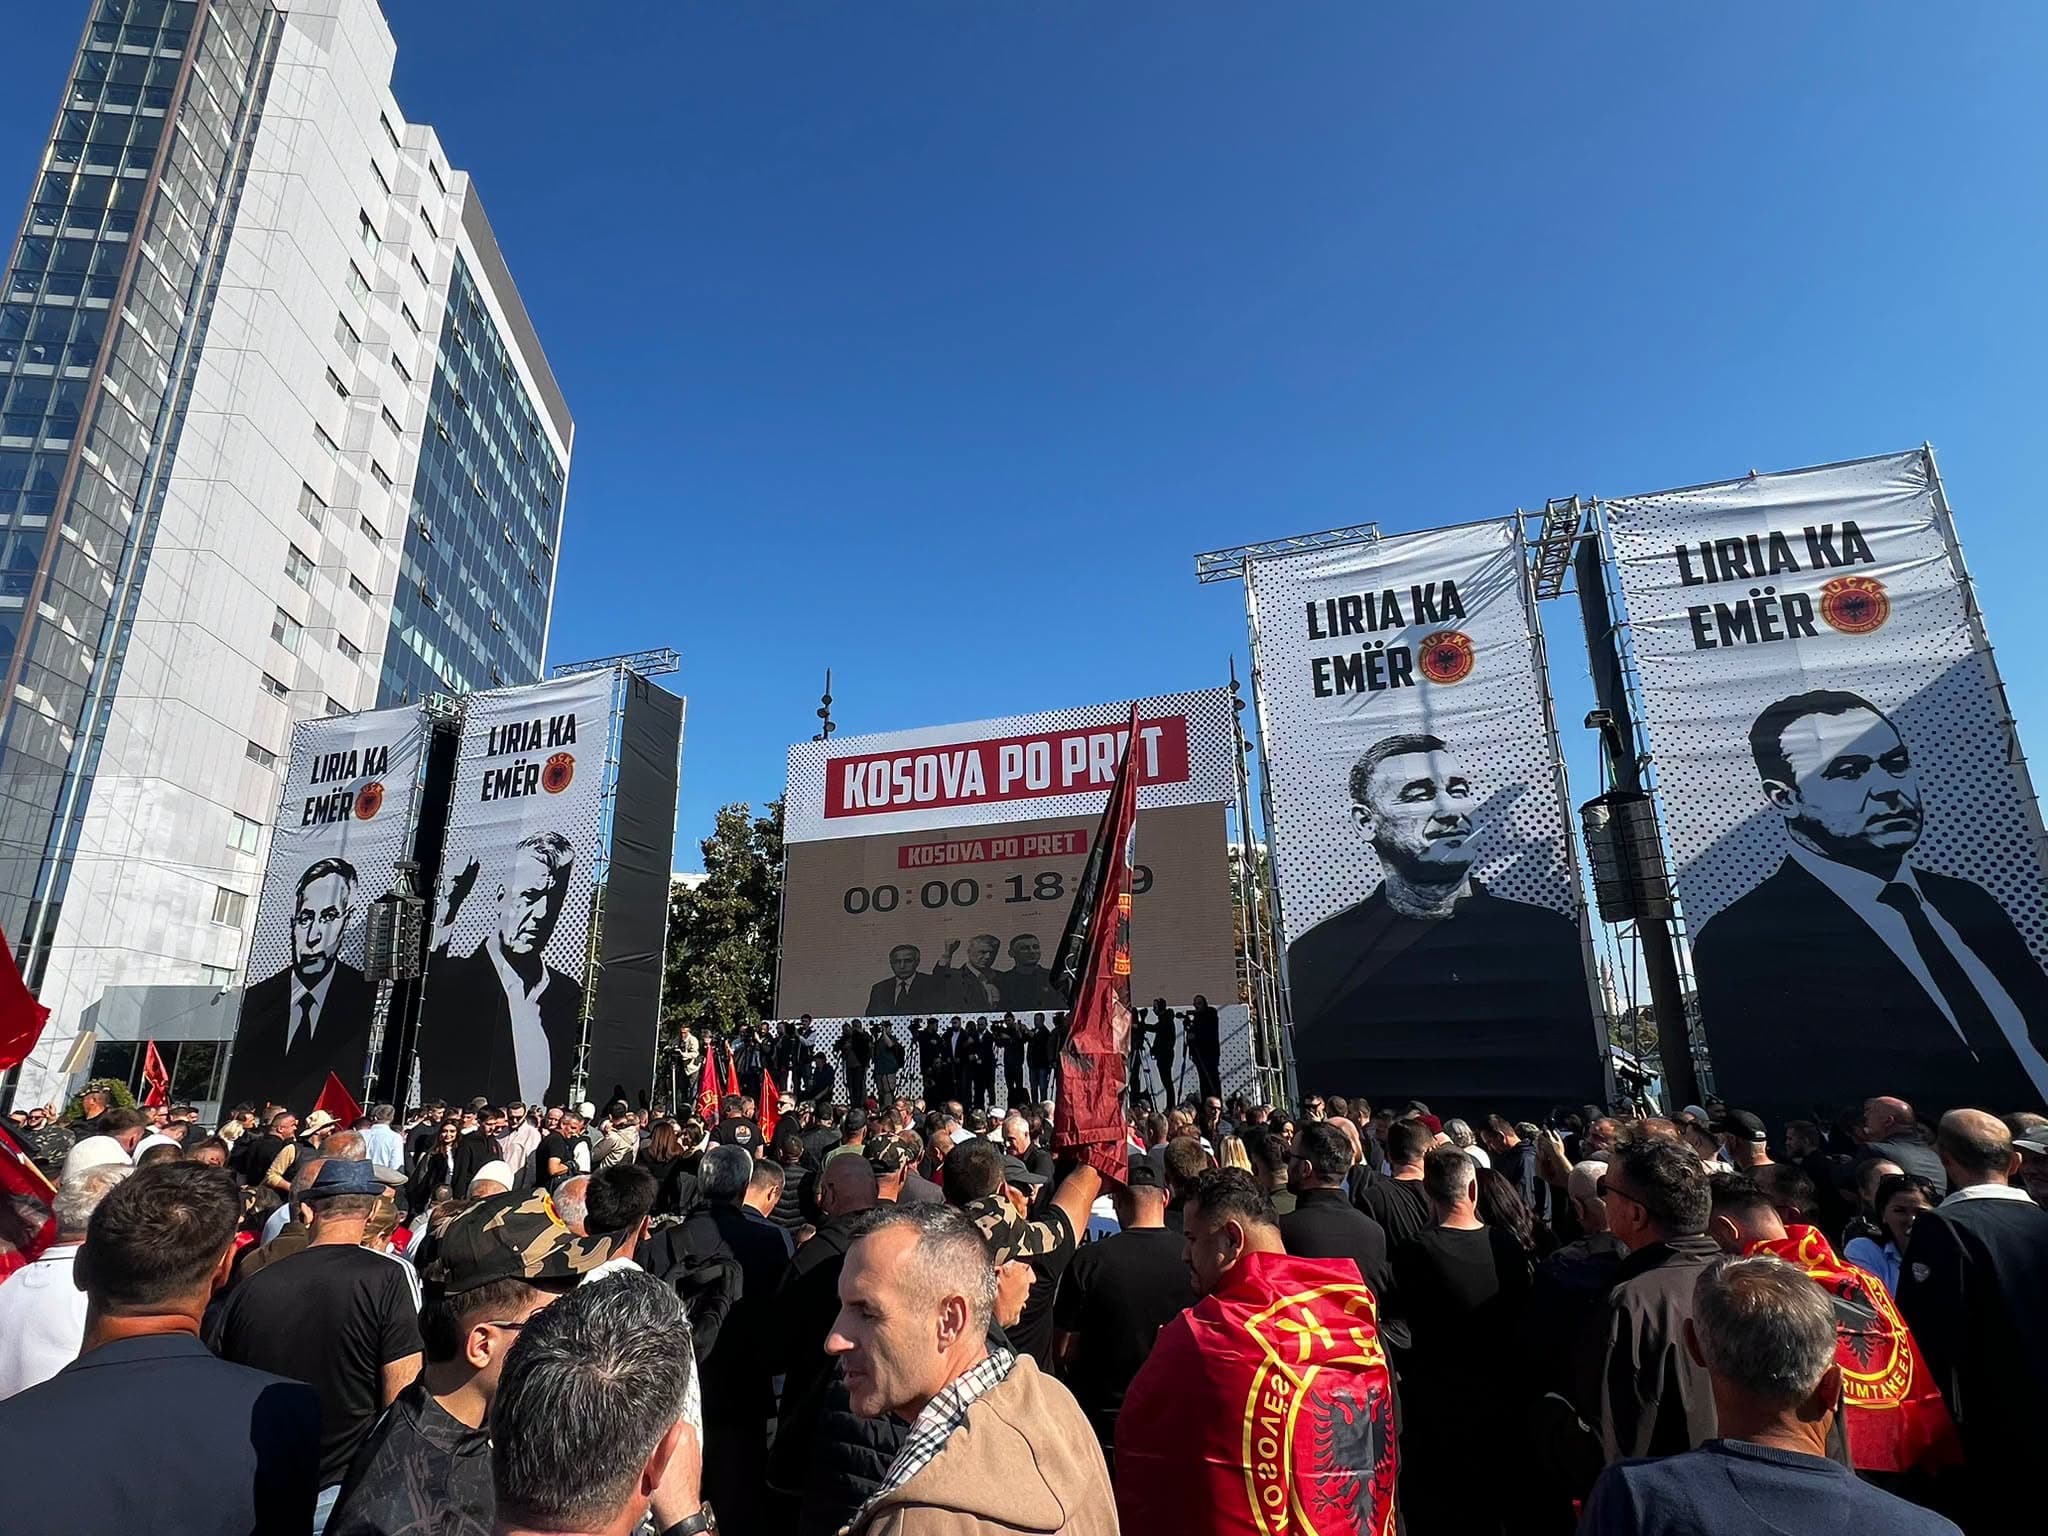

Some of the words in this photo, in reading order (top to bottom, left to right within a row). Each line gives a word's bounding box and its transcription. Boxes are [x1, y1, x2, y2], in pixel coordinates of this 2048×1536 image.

[1675, 530, 1800, 586] LIRIA
[1803, 520, 1875, 570] KA
[1306, 589, 1406, 640] LIRIA
[1411, 579, 1467, 625] KA
[1688, 586, 1819, 650] EMËR
[1311, 639, 1416, 698] EMËR
[488, 720, 542, 757] LIRIA
[547, 713, 577, 748] KA
[310, 750, 357, 785] LIRIA
[362, 746, 388, 777] KA
[481, 758, 540, 801] EMËR
[843, 749, 987, 810] KOSOVA
[1000, 741, 1051, 794] PO
[301, 786, 354, 827] EMËR
[908, 842, 985, 866] KOSOVA
[991, 838, 1019, 859] PO
[1023, 833, 1076, 856] PRET
